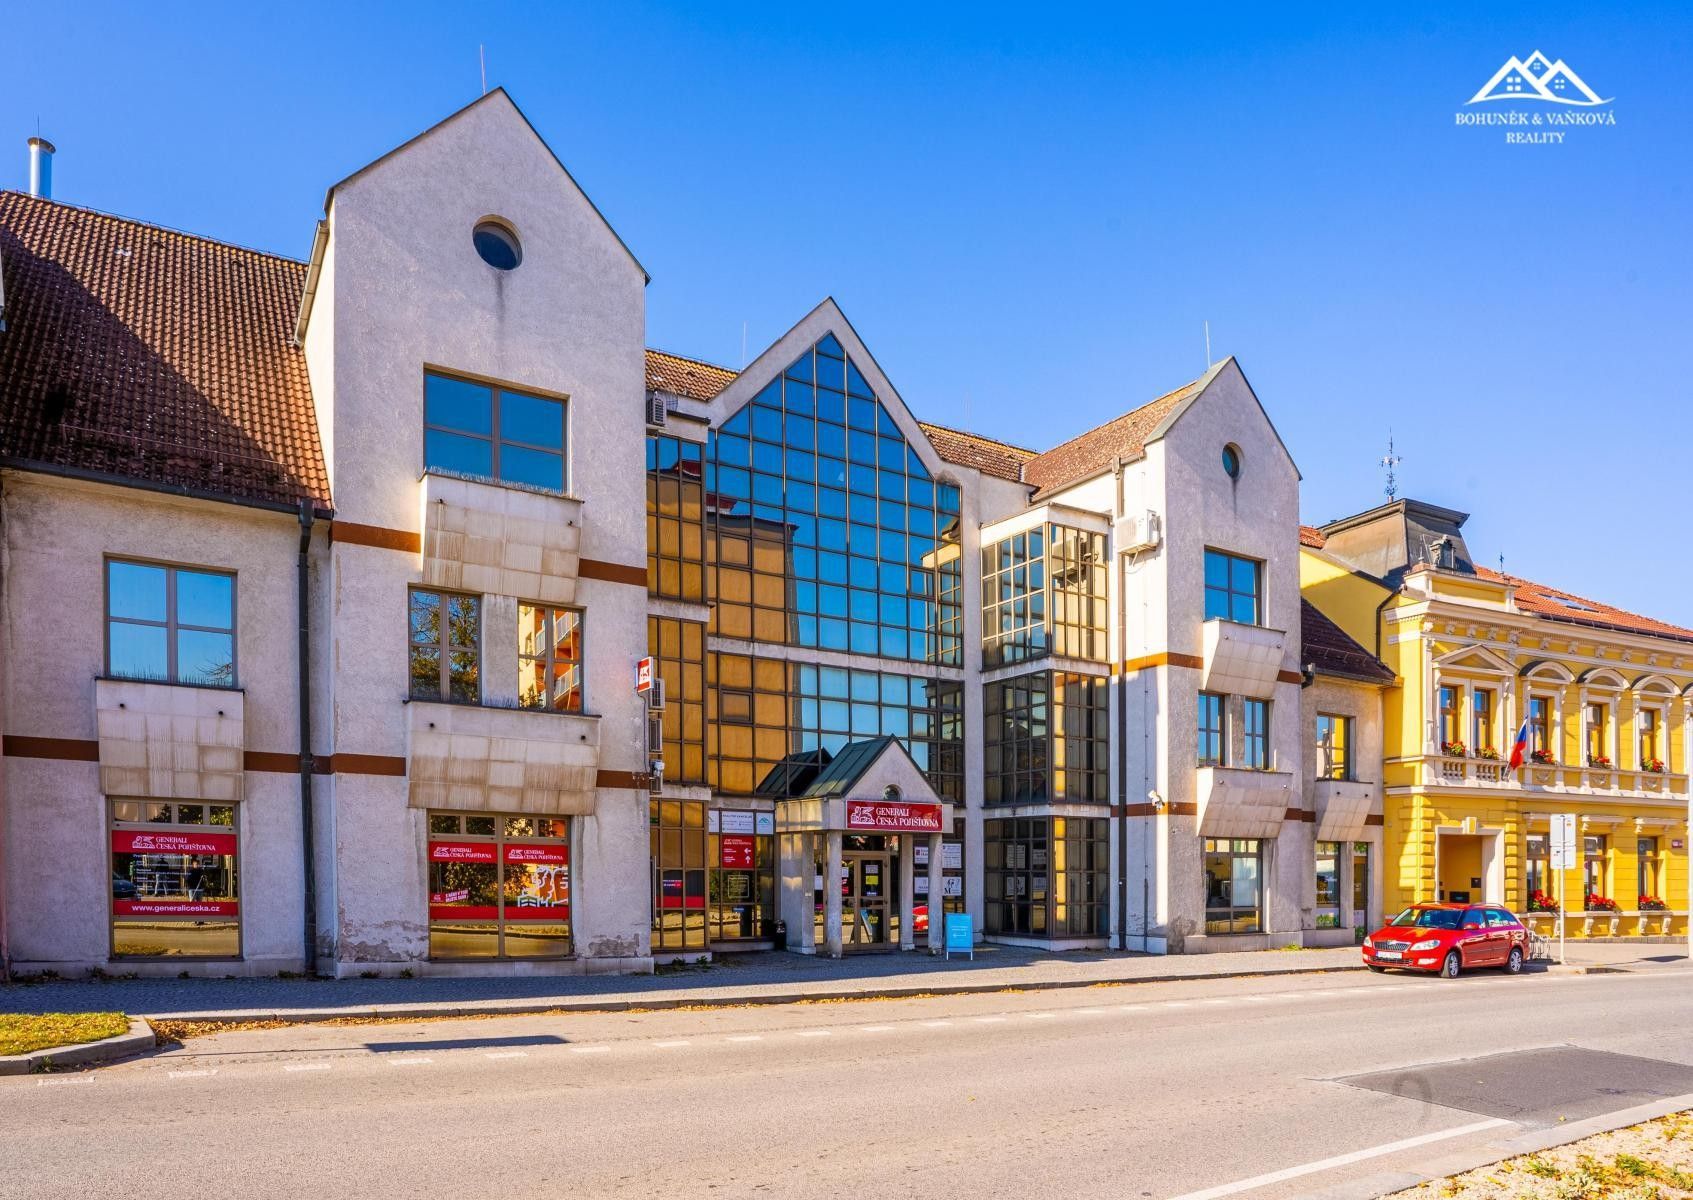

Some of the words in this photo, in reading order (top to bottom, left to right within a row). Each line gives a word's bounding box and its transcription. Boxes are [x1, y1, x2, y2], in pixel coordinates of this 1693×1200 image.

[875, 807, 909, 817] GENERALI
[875, 815, 898, 826] ČESKÁ
[899, 816, 939, 828] POJIŠŤOVNA
[155, 836, 187, 844] GENERALI
[155, 842, 177, 850] ČESKÁ
[131, 904, 221, 913] www.generaliceska.cz
